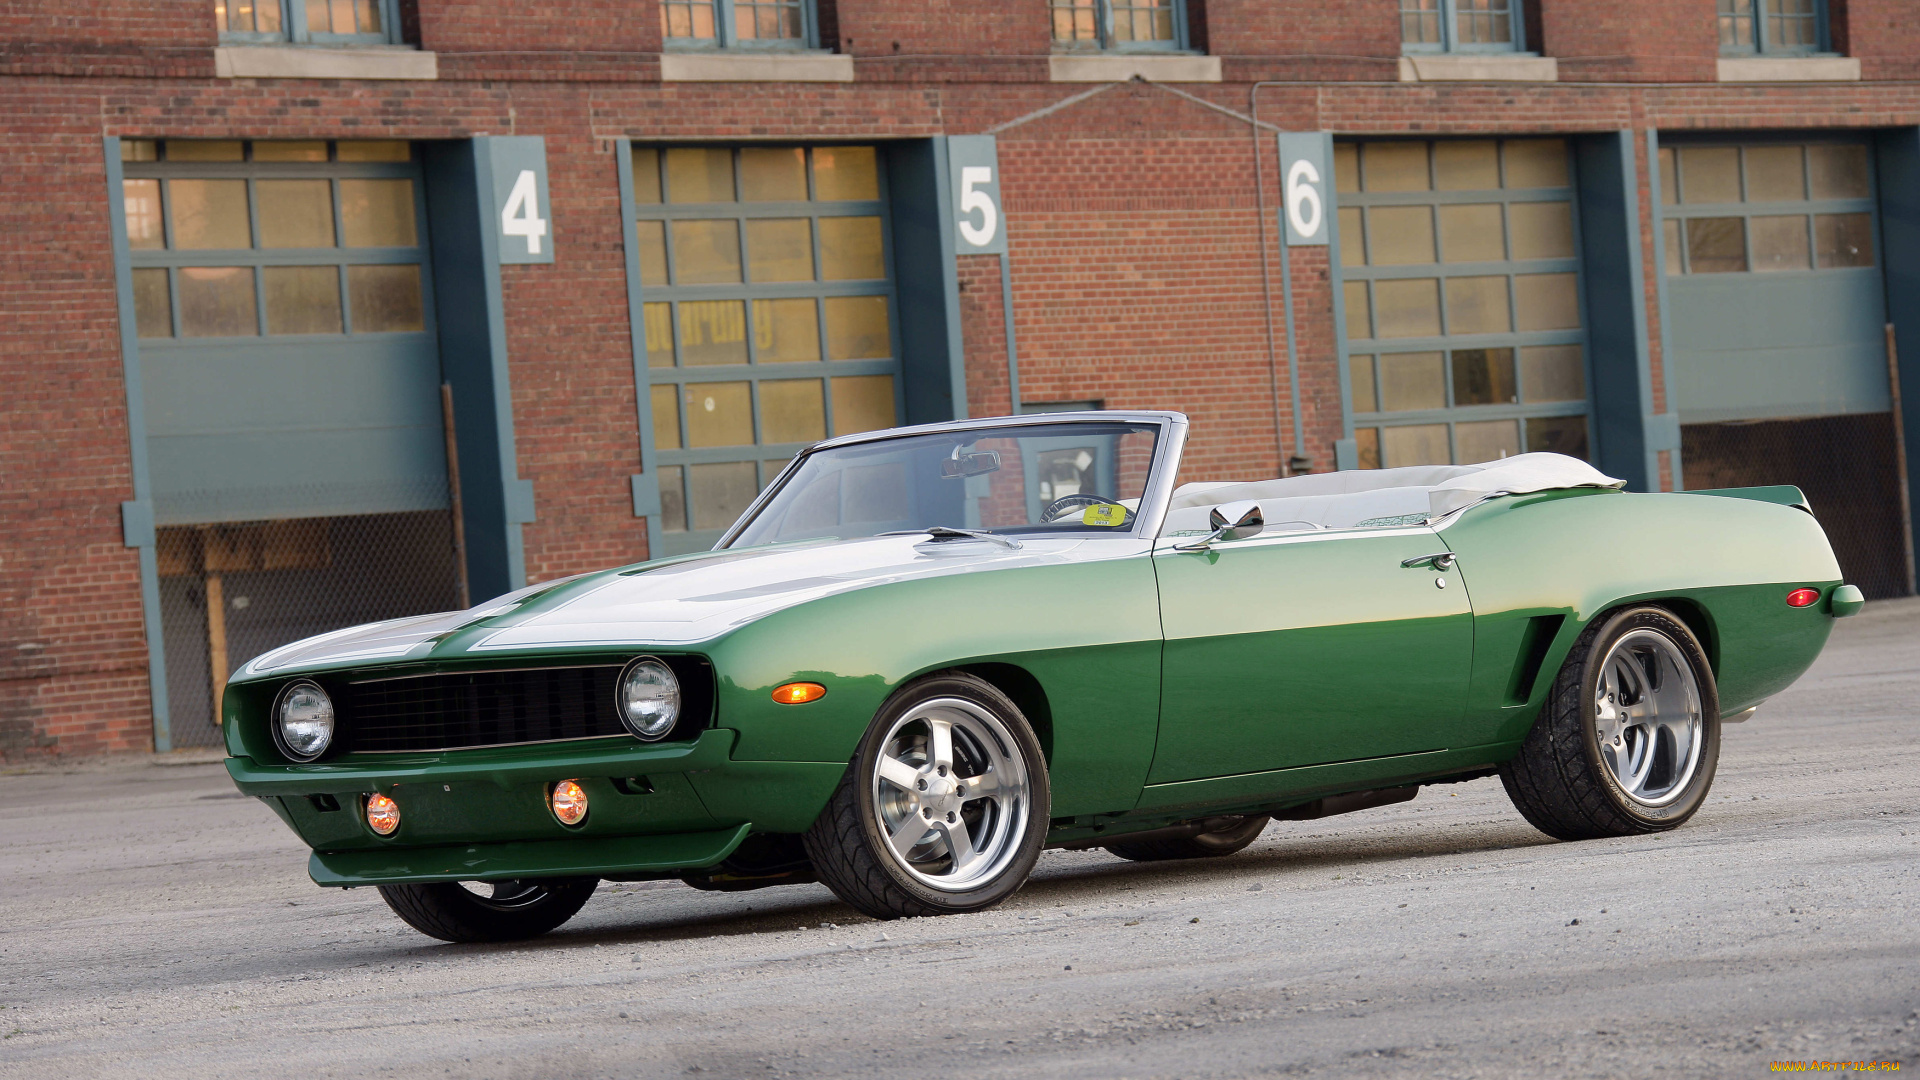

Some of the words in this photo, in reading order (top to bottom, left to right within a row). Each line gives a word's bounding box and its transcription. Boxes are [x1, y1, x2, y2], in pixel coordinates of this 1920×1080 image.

[501, 169, 547, 254] 4
[959, 166, 997, 247] 5
[1287, 159, 1322, 238] 6
